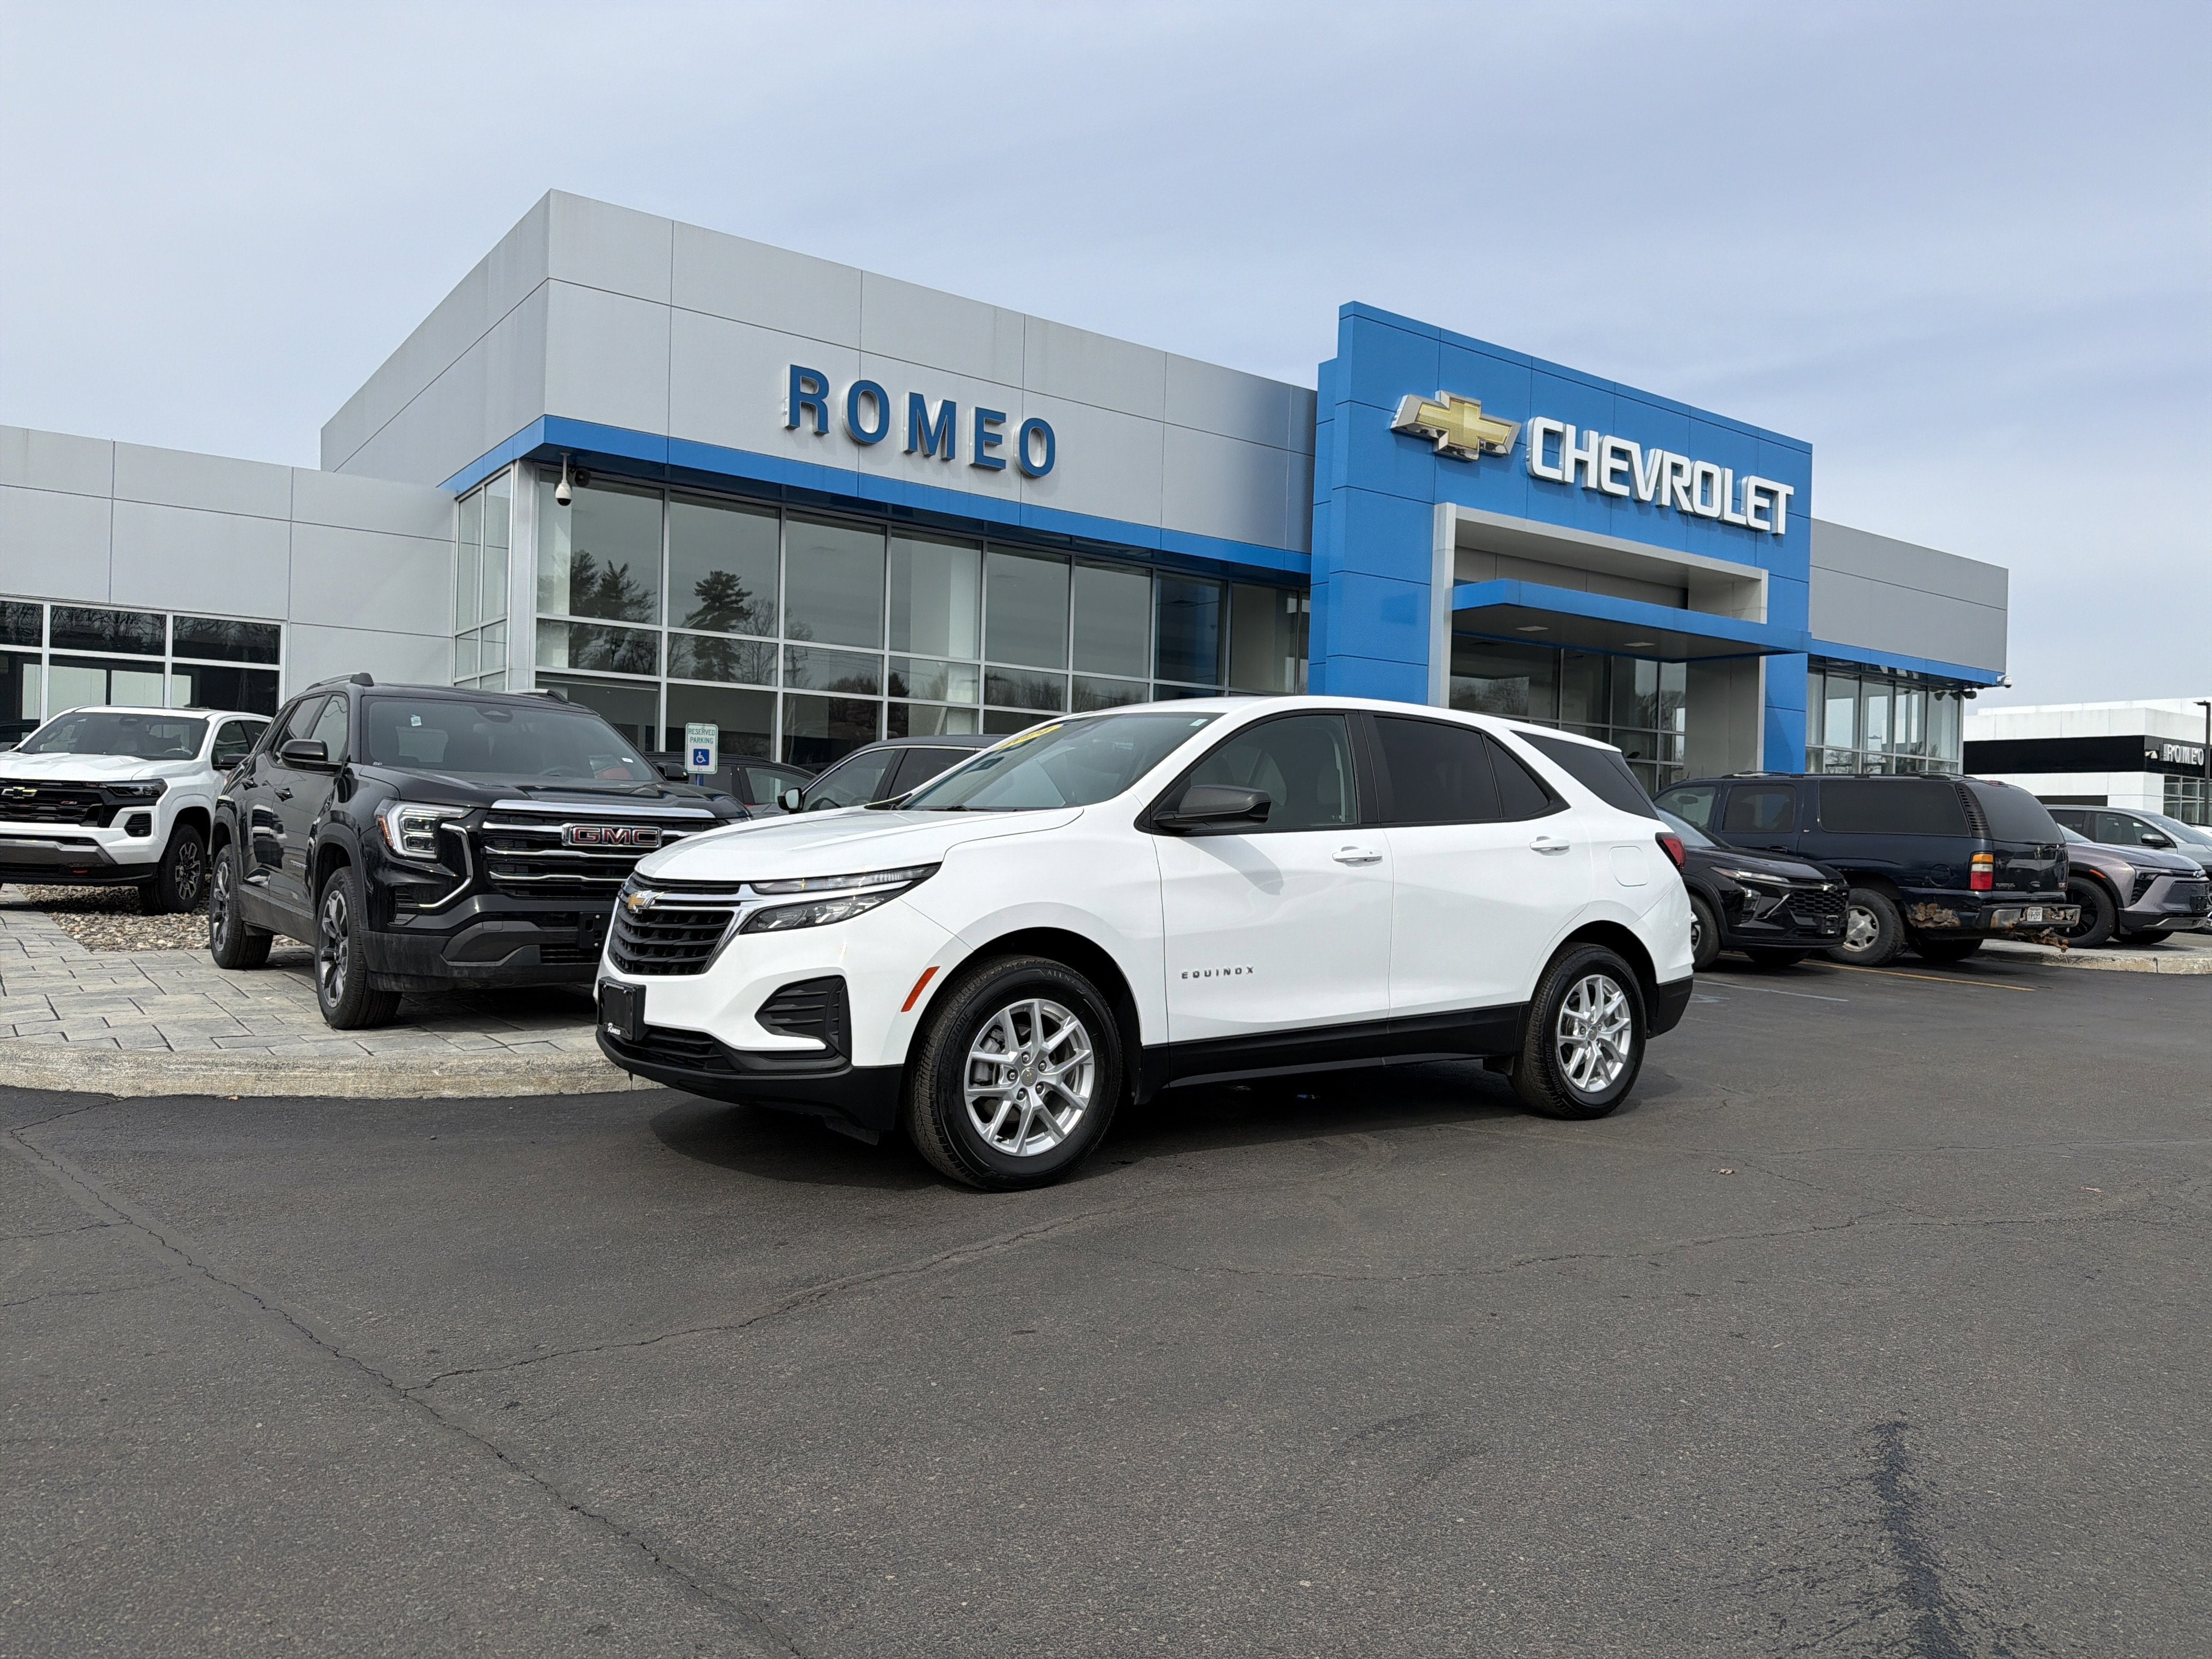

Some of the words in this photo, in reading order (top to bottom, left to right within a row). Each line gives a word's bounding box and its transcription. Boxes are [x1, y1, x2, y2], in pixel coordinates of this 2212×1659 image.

[785, 364, 1056, 478] ROMEO
[1526, 415, 1794, 535] CHEVROLET
[688, 728, 715, 736] RESERVED
[690, 736, 714, 744] PARKING
[2164, 744, 2204, 766] ROMEO
[573, 827, 658, 845] GMC
[1181, 966, 1254, 979] EQUINOX
